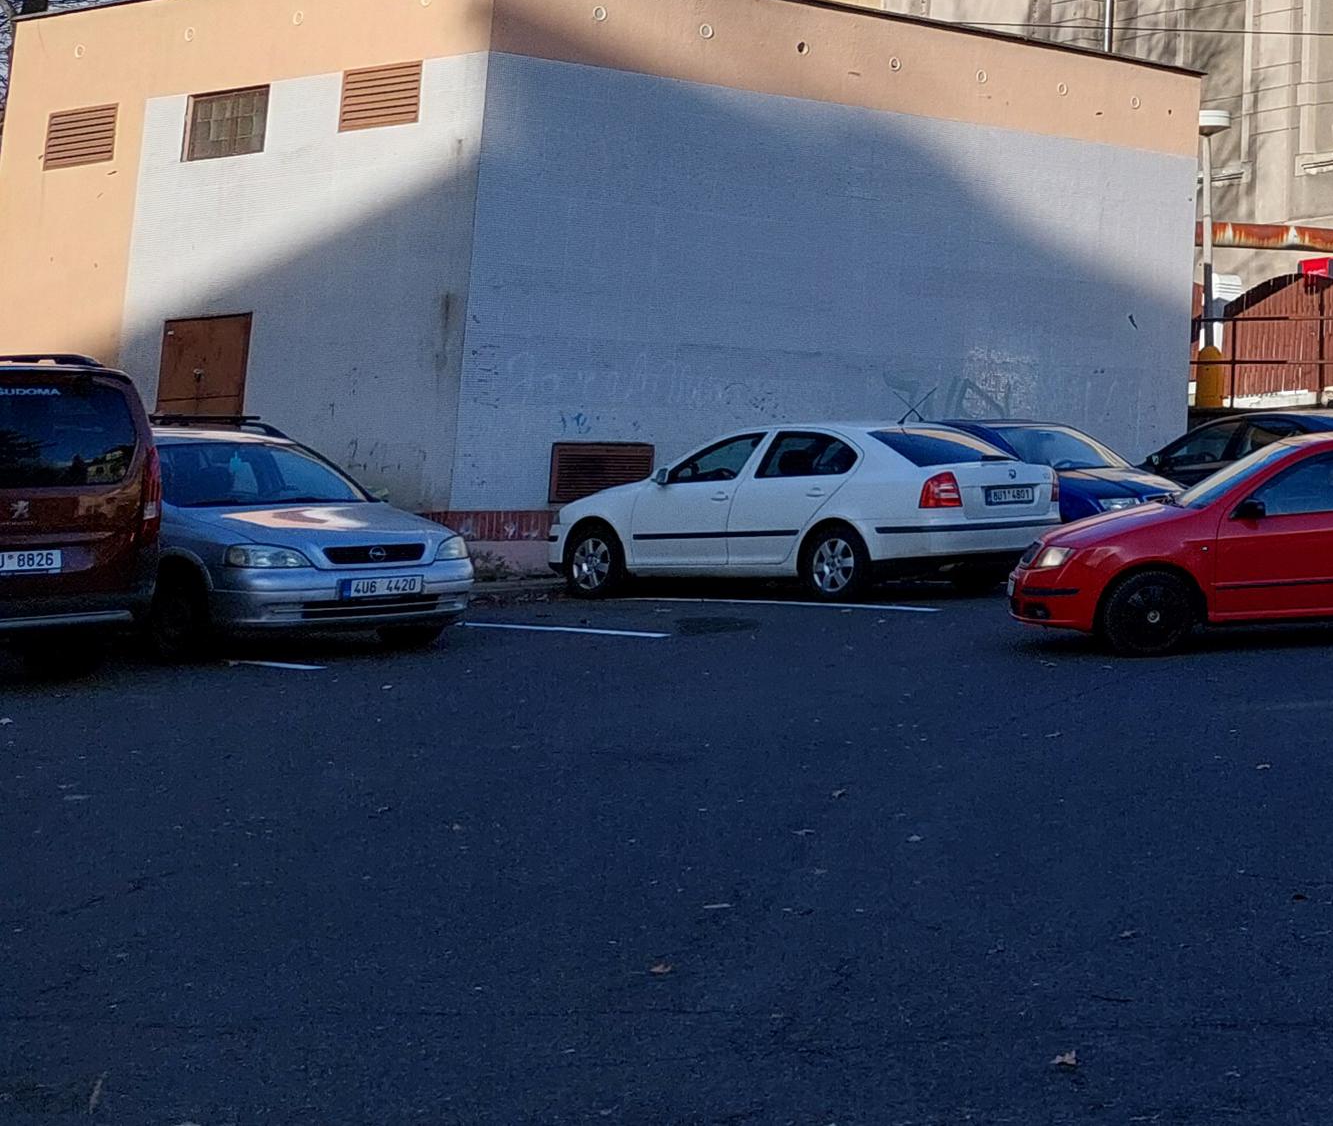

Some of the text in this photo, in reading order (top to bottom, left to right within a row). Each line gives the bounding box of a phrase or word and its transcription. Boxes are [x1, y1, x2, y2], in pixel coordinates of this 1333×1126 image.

[17, 553, 54, 567] 8826
[353, 577, 416, 594] 4U6 4420
